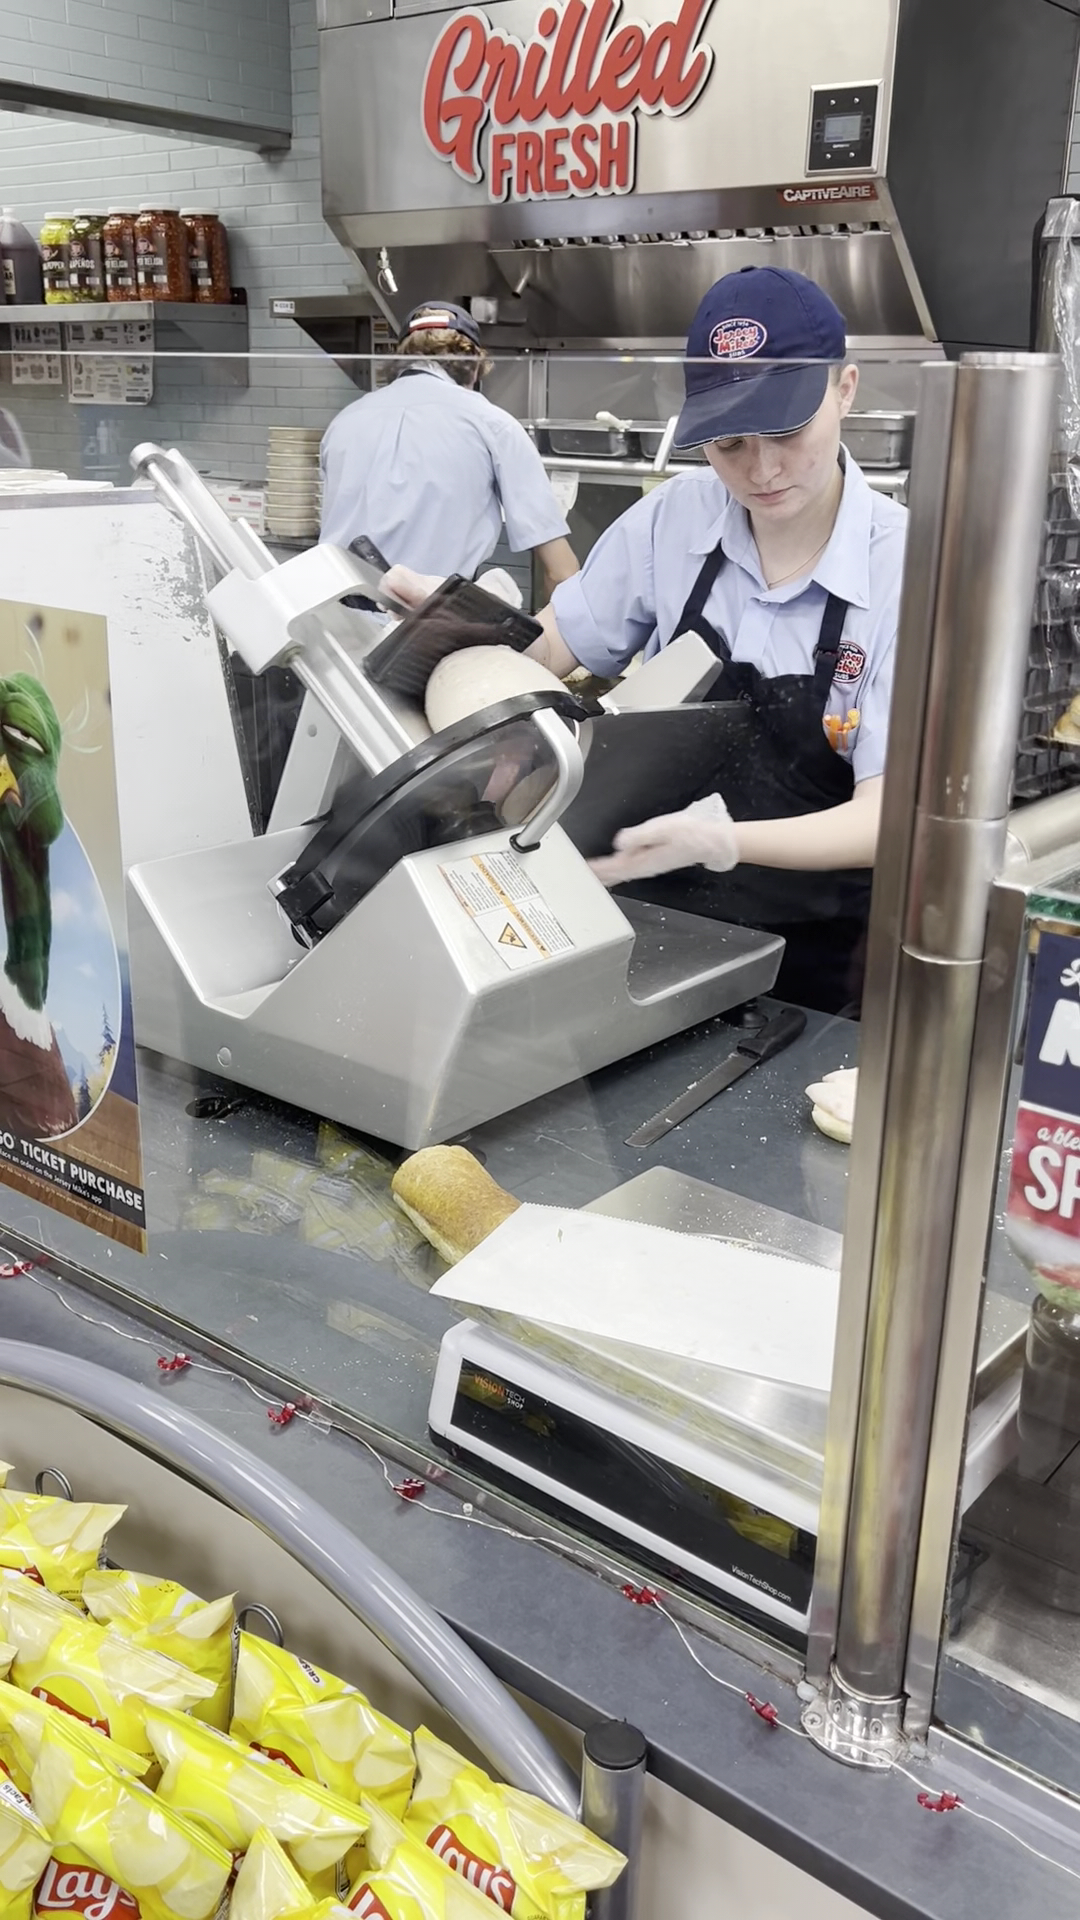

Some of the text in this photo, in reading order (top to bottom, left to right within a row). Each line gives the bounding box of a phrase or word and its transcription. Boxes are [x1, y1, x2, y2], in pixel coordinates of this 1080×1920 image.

[424, 0, 706, 176] Grilled
[492, 121, 629, 197] FRESH
[713, 326, 758, 343] Jersey
[717, 336, 760, 355] Mike's
[20, 1139, 67, 1174] TICKET
[70, 1162, 143, 1211] PURCHASE
[43, 1170, 53, 1180] the
[54, 1175, 71, 1191] Jersey
[91, 1194, 103, 1205] app
[507, 1397, 524, 1410] SHOP
[731, 1564, 792, 1603] VisionTechShop.com
